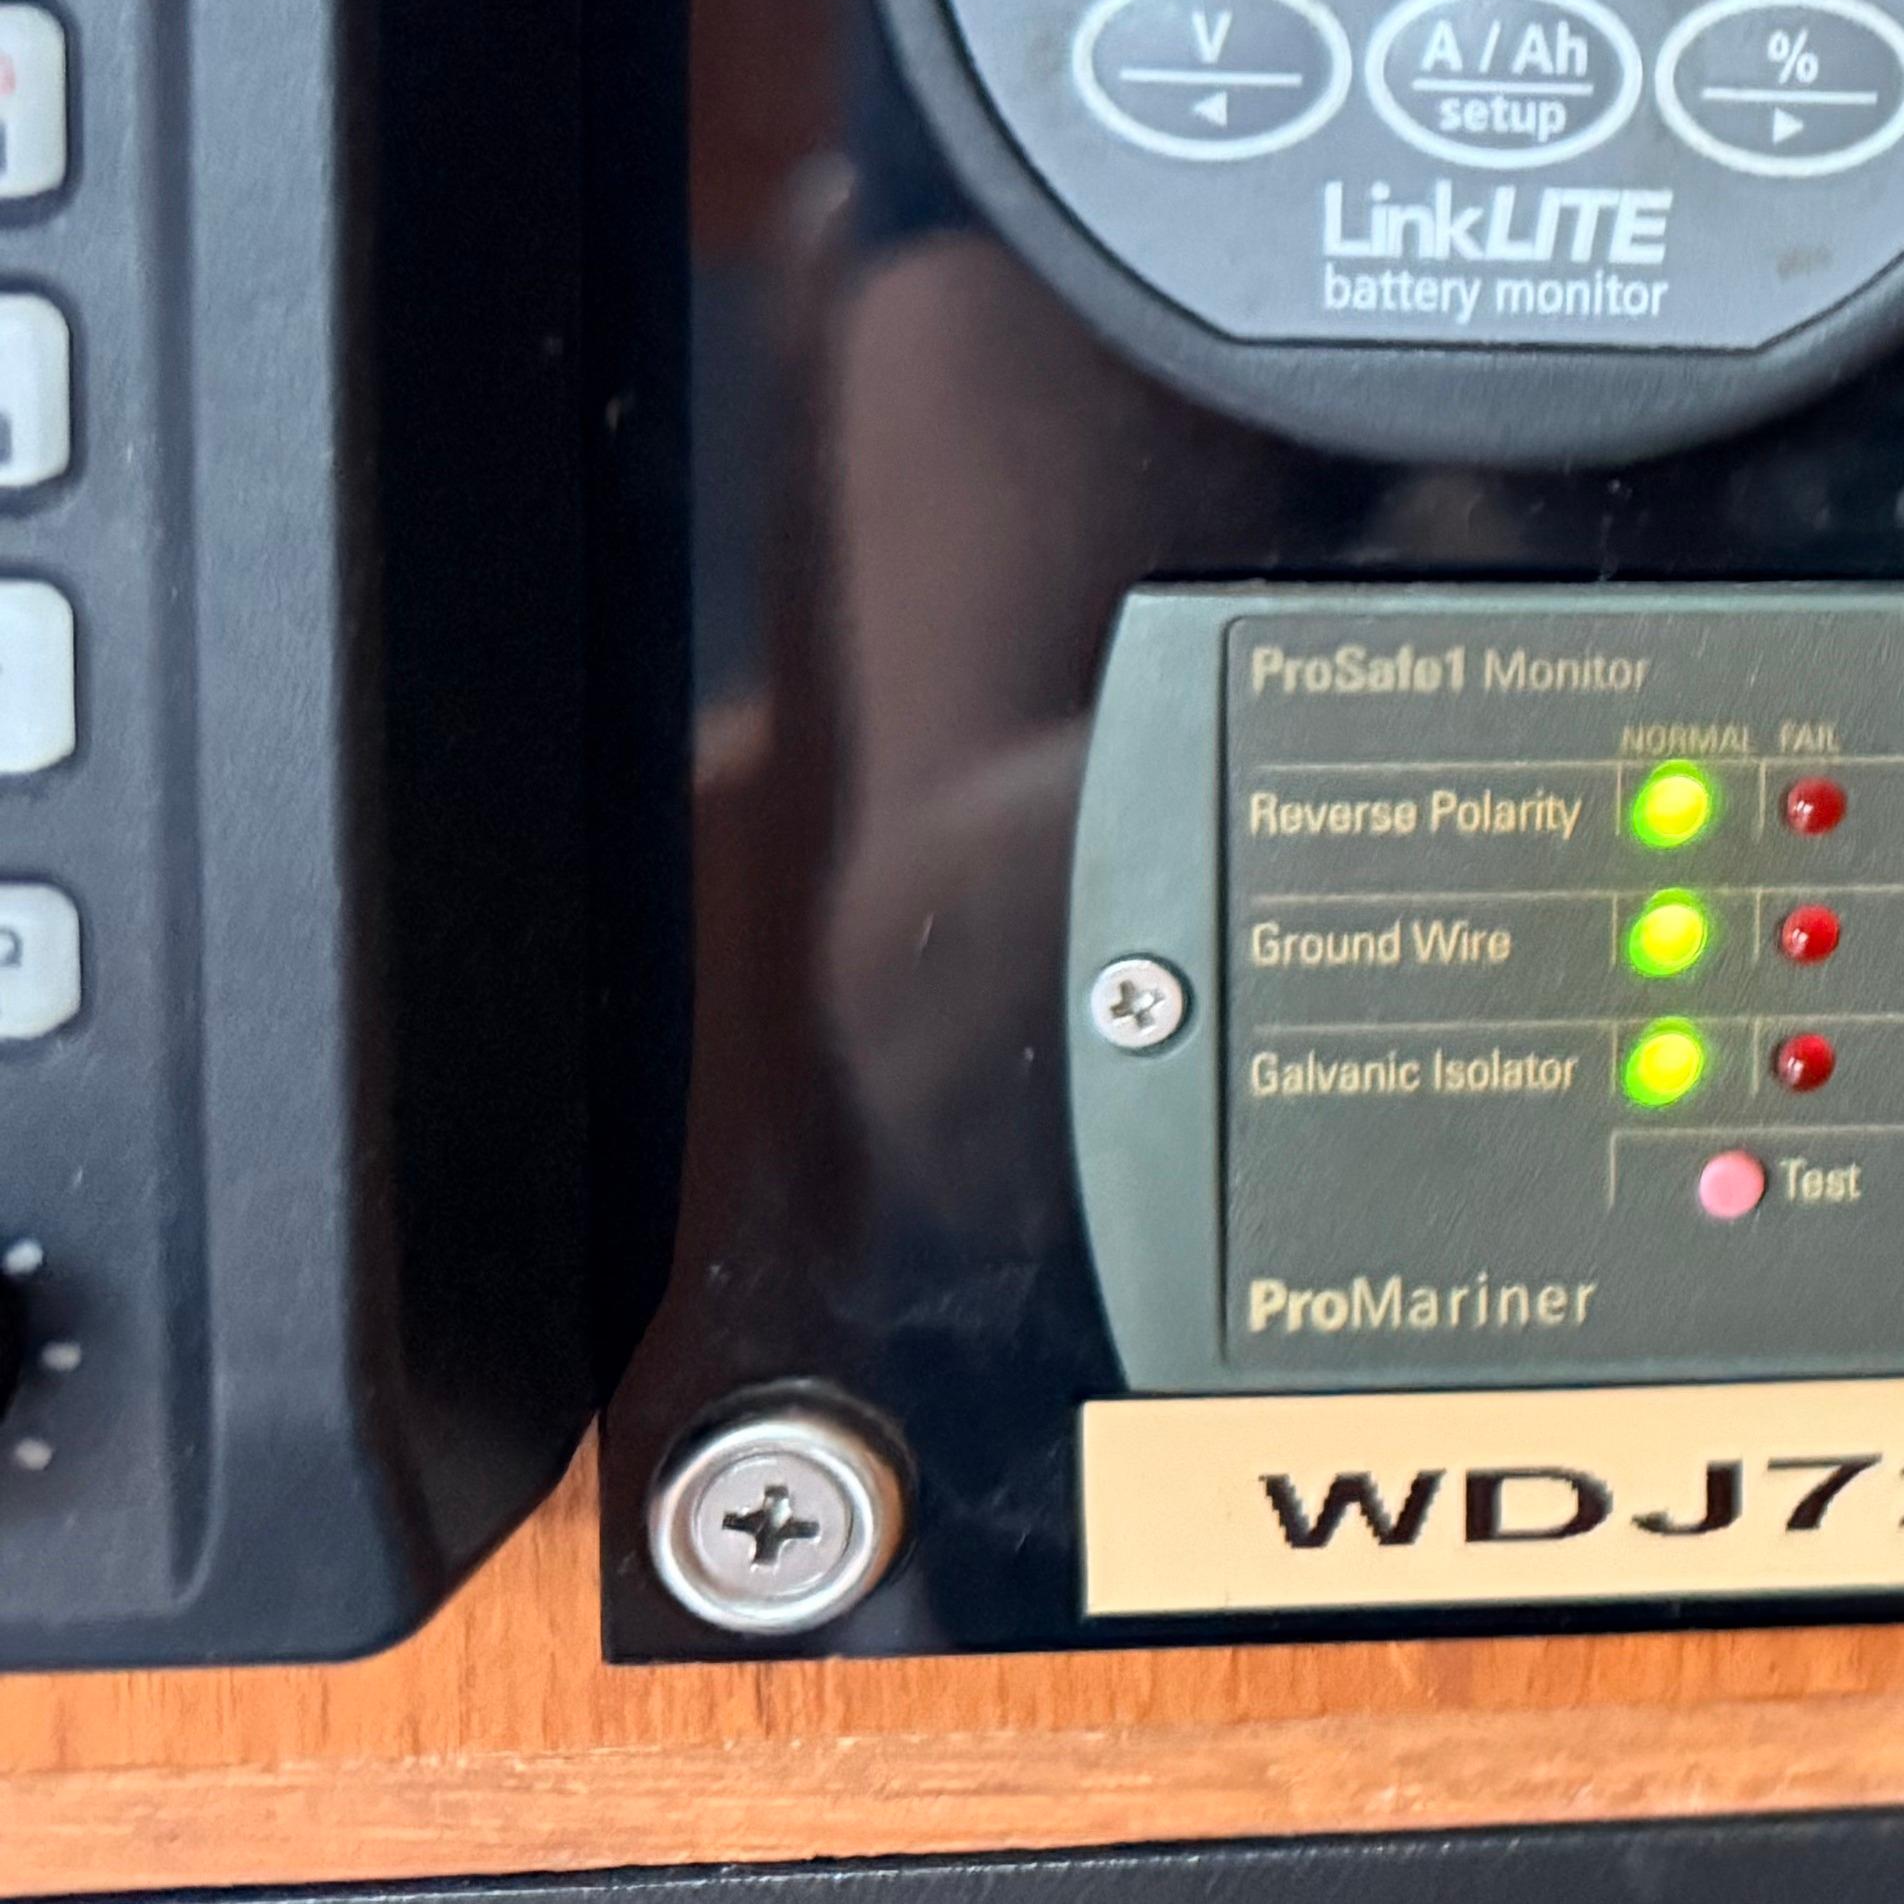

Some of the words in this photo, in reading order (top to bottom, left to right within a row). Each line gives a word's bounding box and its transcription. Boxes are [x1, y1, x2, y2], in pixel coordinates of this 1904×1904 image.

[1190, 9, 1234, 64] V
[1767, 32, 1820, 84] %
[1438, 92, 1568, 142] setup
[1322, 184, 1674, 264] LinkLITE
[1324, 268, 1480, 326] battery
[1494, 276, 1670, 318] monitor
[1482, 650, 1650, 696] Monitor
[1620, 726, 1754, 756] NORMAL
[1776, 726, 1842, 756] FAIL
[1248, 794, 1416, 836] Reverse
[1428, 792, 1582, 844] Polarity
[1250, 922, 1404, 968] Ground
[1412, 920, 1514, 964] Wire
[1250, 1052, 1420, 1096] Galvanic
[1432, 1050, 1580, 1094] Isolator
[1780, 1158, 1862, 1204] Test
[1248, 1274, 1596, 1332] ProMariner
